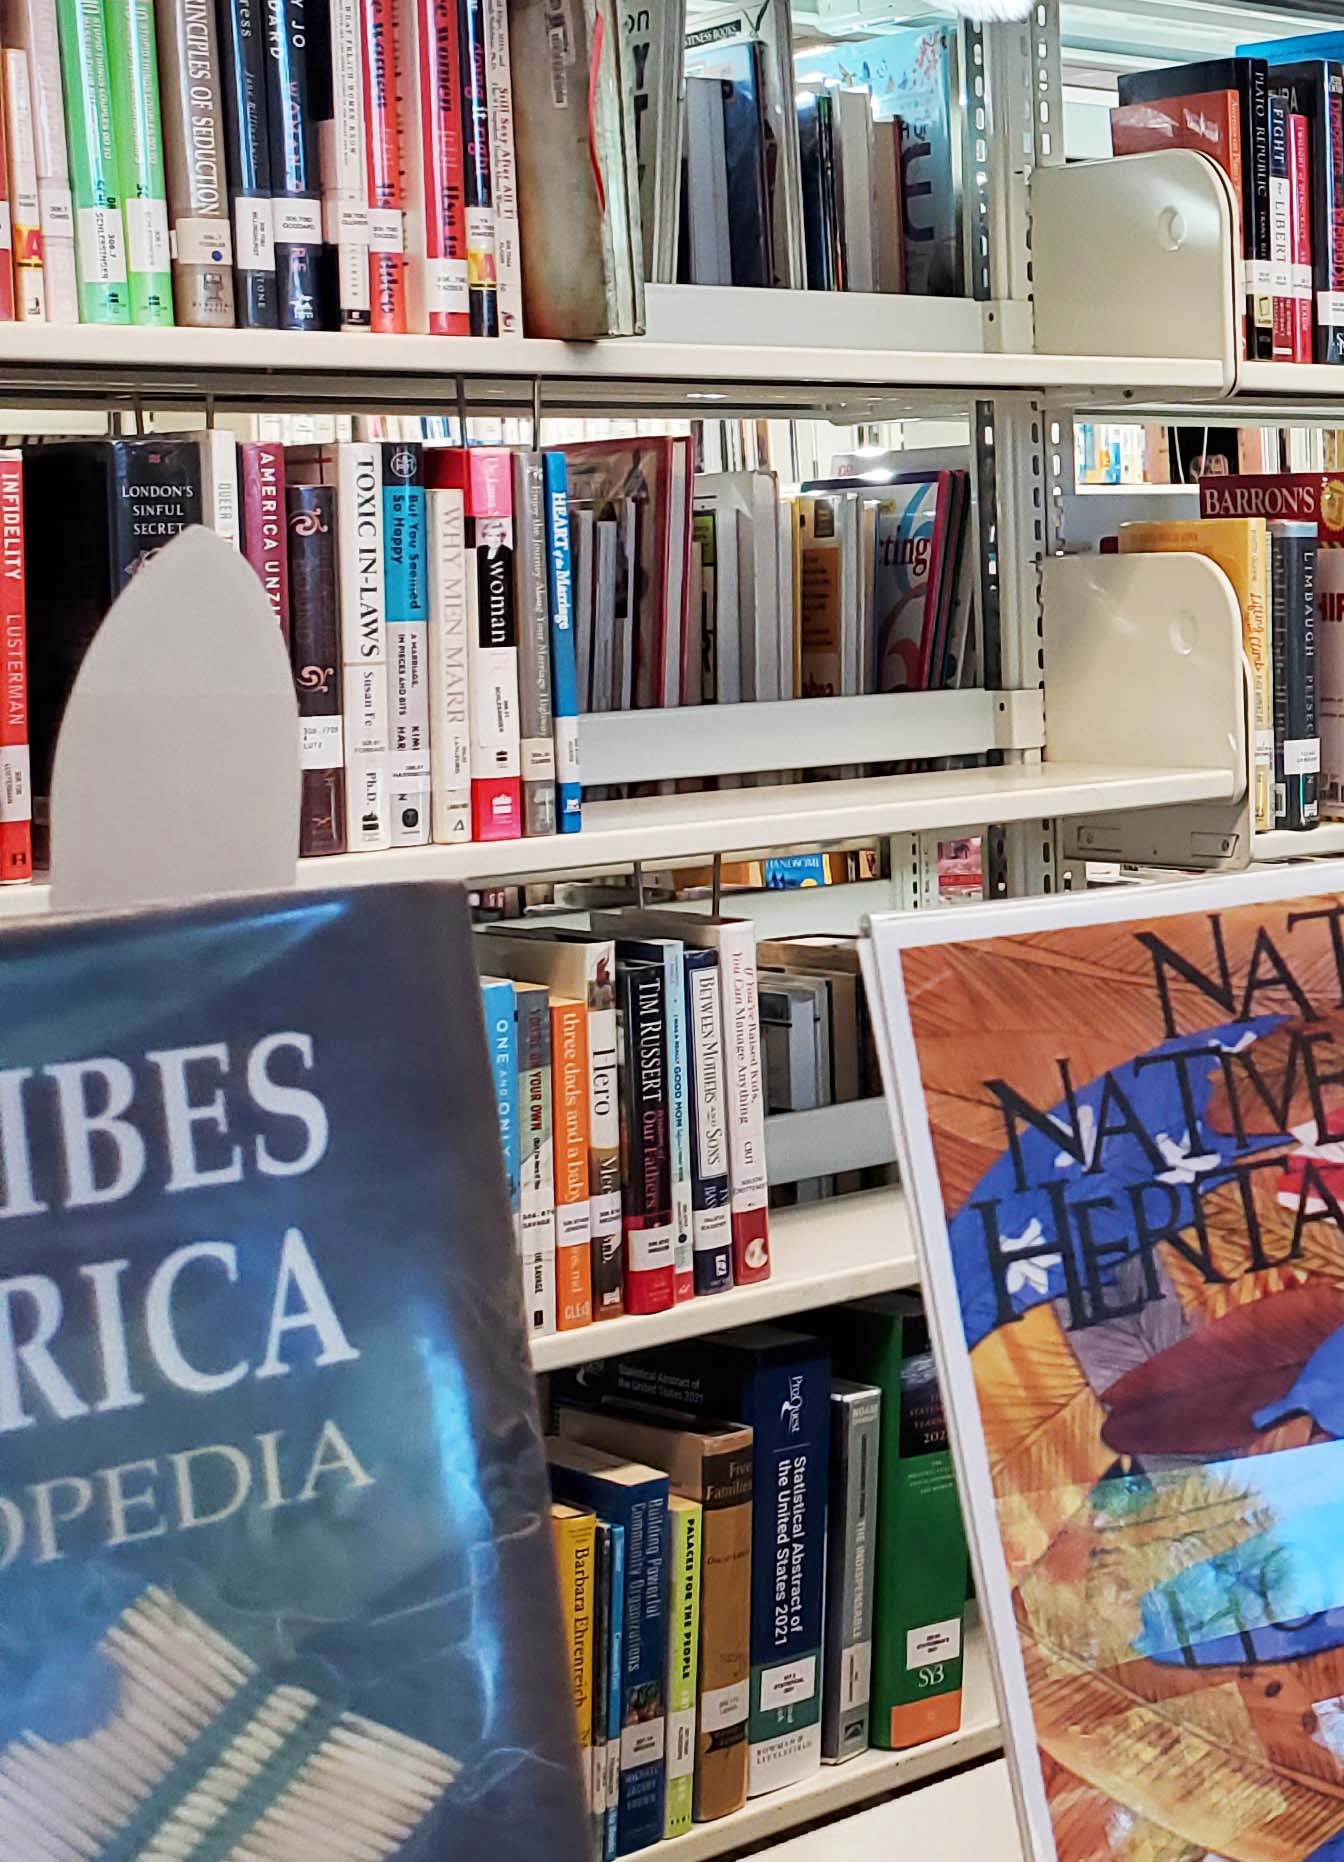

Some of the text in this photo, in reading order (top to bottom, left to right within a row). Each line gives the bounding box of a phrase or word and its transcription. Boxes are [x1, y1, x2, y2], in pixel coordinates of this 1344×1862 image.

[291, 22, 306, 49] JO
[190, 87, 213, 110] OF
[1254, 71, 1268, 197] PLATO REPUBLIC
[190, 112, 221, 216] SEDUCTION
[2, 472, 24, 581] INFIDELITY
[121, 484, 194, 499] LONDON'S
[132, 502, 185, 517] SINFUL
[218, 482, 233, 521] QUEER
[392, 493, 407, 566] So Happy
[1203, 486, 1317, 523] BARRON'S
[357, 455, 380, 658] TOXIC IN-LAWS
[409, 494, 421, 610] But You Seemed
[441, 505, 463, 560] WHY
[443, 576, 464, 637] MEN
[489, 559, 507, 644] woman
[1302, 551, 1315, 657] LIMBAUGH
[7, 614, 26, 726] LUSTERMAN
[365, 771, 379, 809] Ph.D.
[561, 1011, 577, 1058] three
[638, 977, 662, 1102] TIM RUSSERT
[731, 952, 751, 1125] You Can Manage Anything
[563, 1060, 579, 1106] dads
[592, 1047, 616, 1116] Hero
[565, 1108, 581, 1143] and
[564, 1160, 582, 1203] baby
[779, 1374, 804, 1434] ProQuest
[644, 1497, 664, 1618] Building Powerful
[774, 1459, 792, 1646] the United States 2021
[789, 1455, 808, 1633] Statistical Abstract of
[627, 1501, 647, 1672] Community Organizations
[682, 1517, 696, 1679] PALACES FOR THE PEOPLE
[572, 1545, 590, 1708] Barbara Ehrenreich
